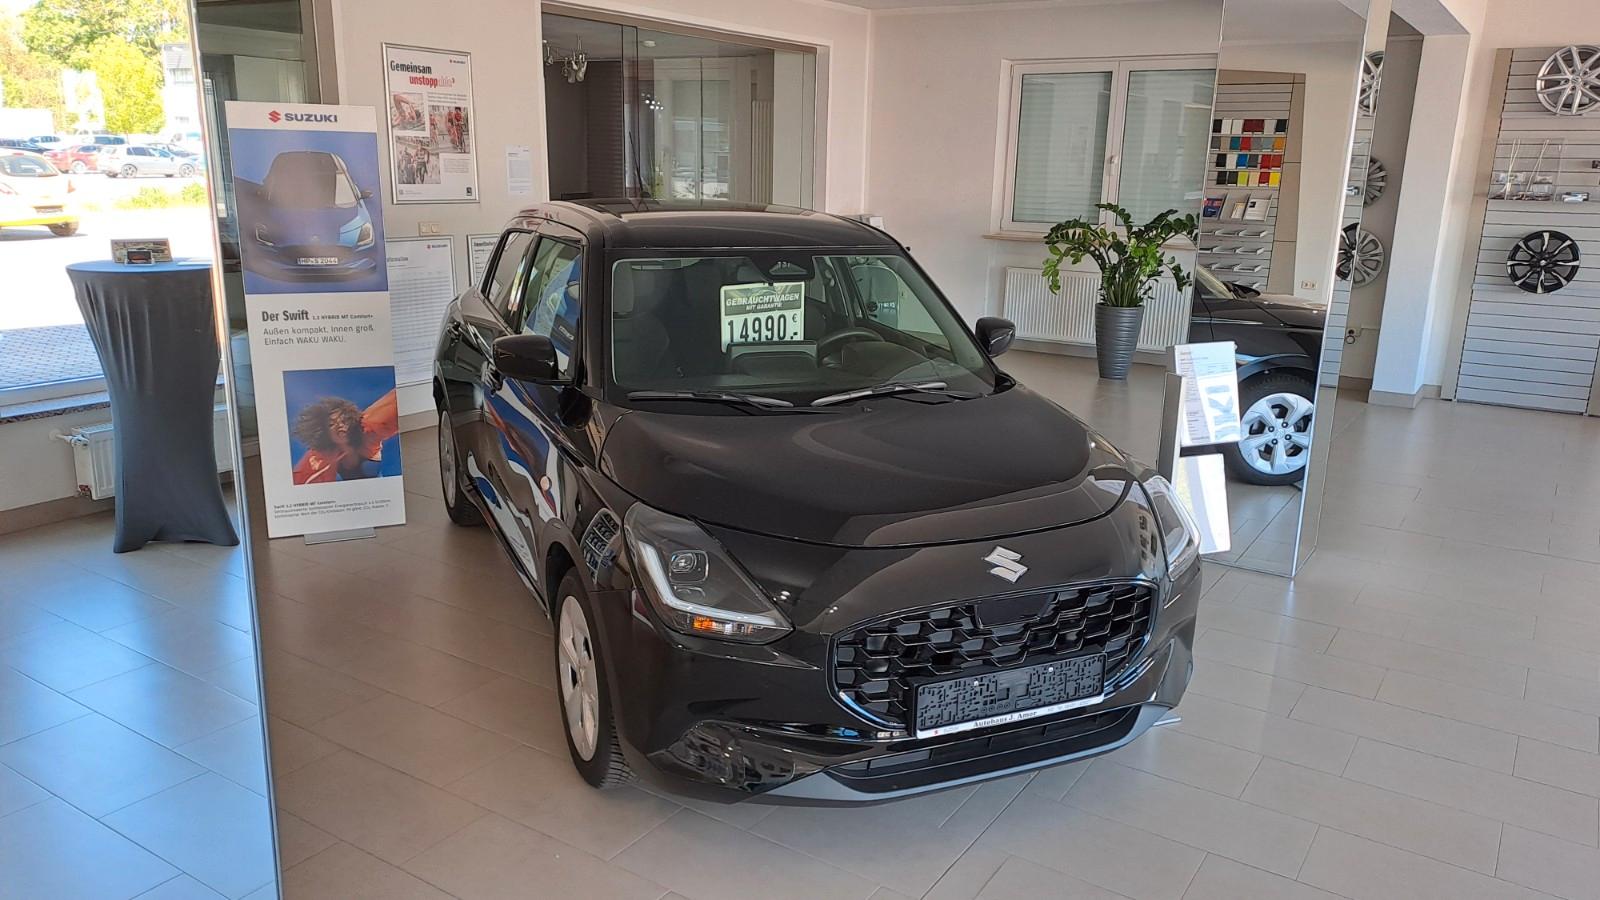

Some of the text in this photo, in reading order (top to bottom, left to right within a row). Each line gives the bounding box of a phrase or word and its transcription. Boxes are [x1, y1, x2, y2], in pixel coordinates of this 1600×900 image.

[390, 60, 432, 75] Gemeinsam
[284, 113, 338, 123] SUZUKI
[726, 293, 800, 307] GEBRAUCHTWAGEN
[756, 302, 783, 310] GARANTIE
[262, 311, 279, 322] Der
[283, 310, 309, 321] Swift
[263, 327, 289, 336] Außen
[331, 324, 354, 333] Innen
[264, 335, 346, 345] Einfach WAKU WAKU.
[973, 711, 1037, 728] Autohaus J. Amor
